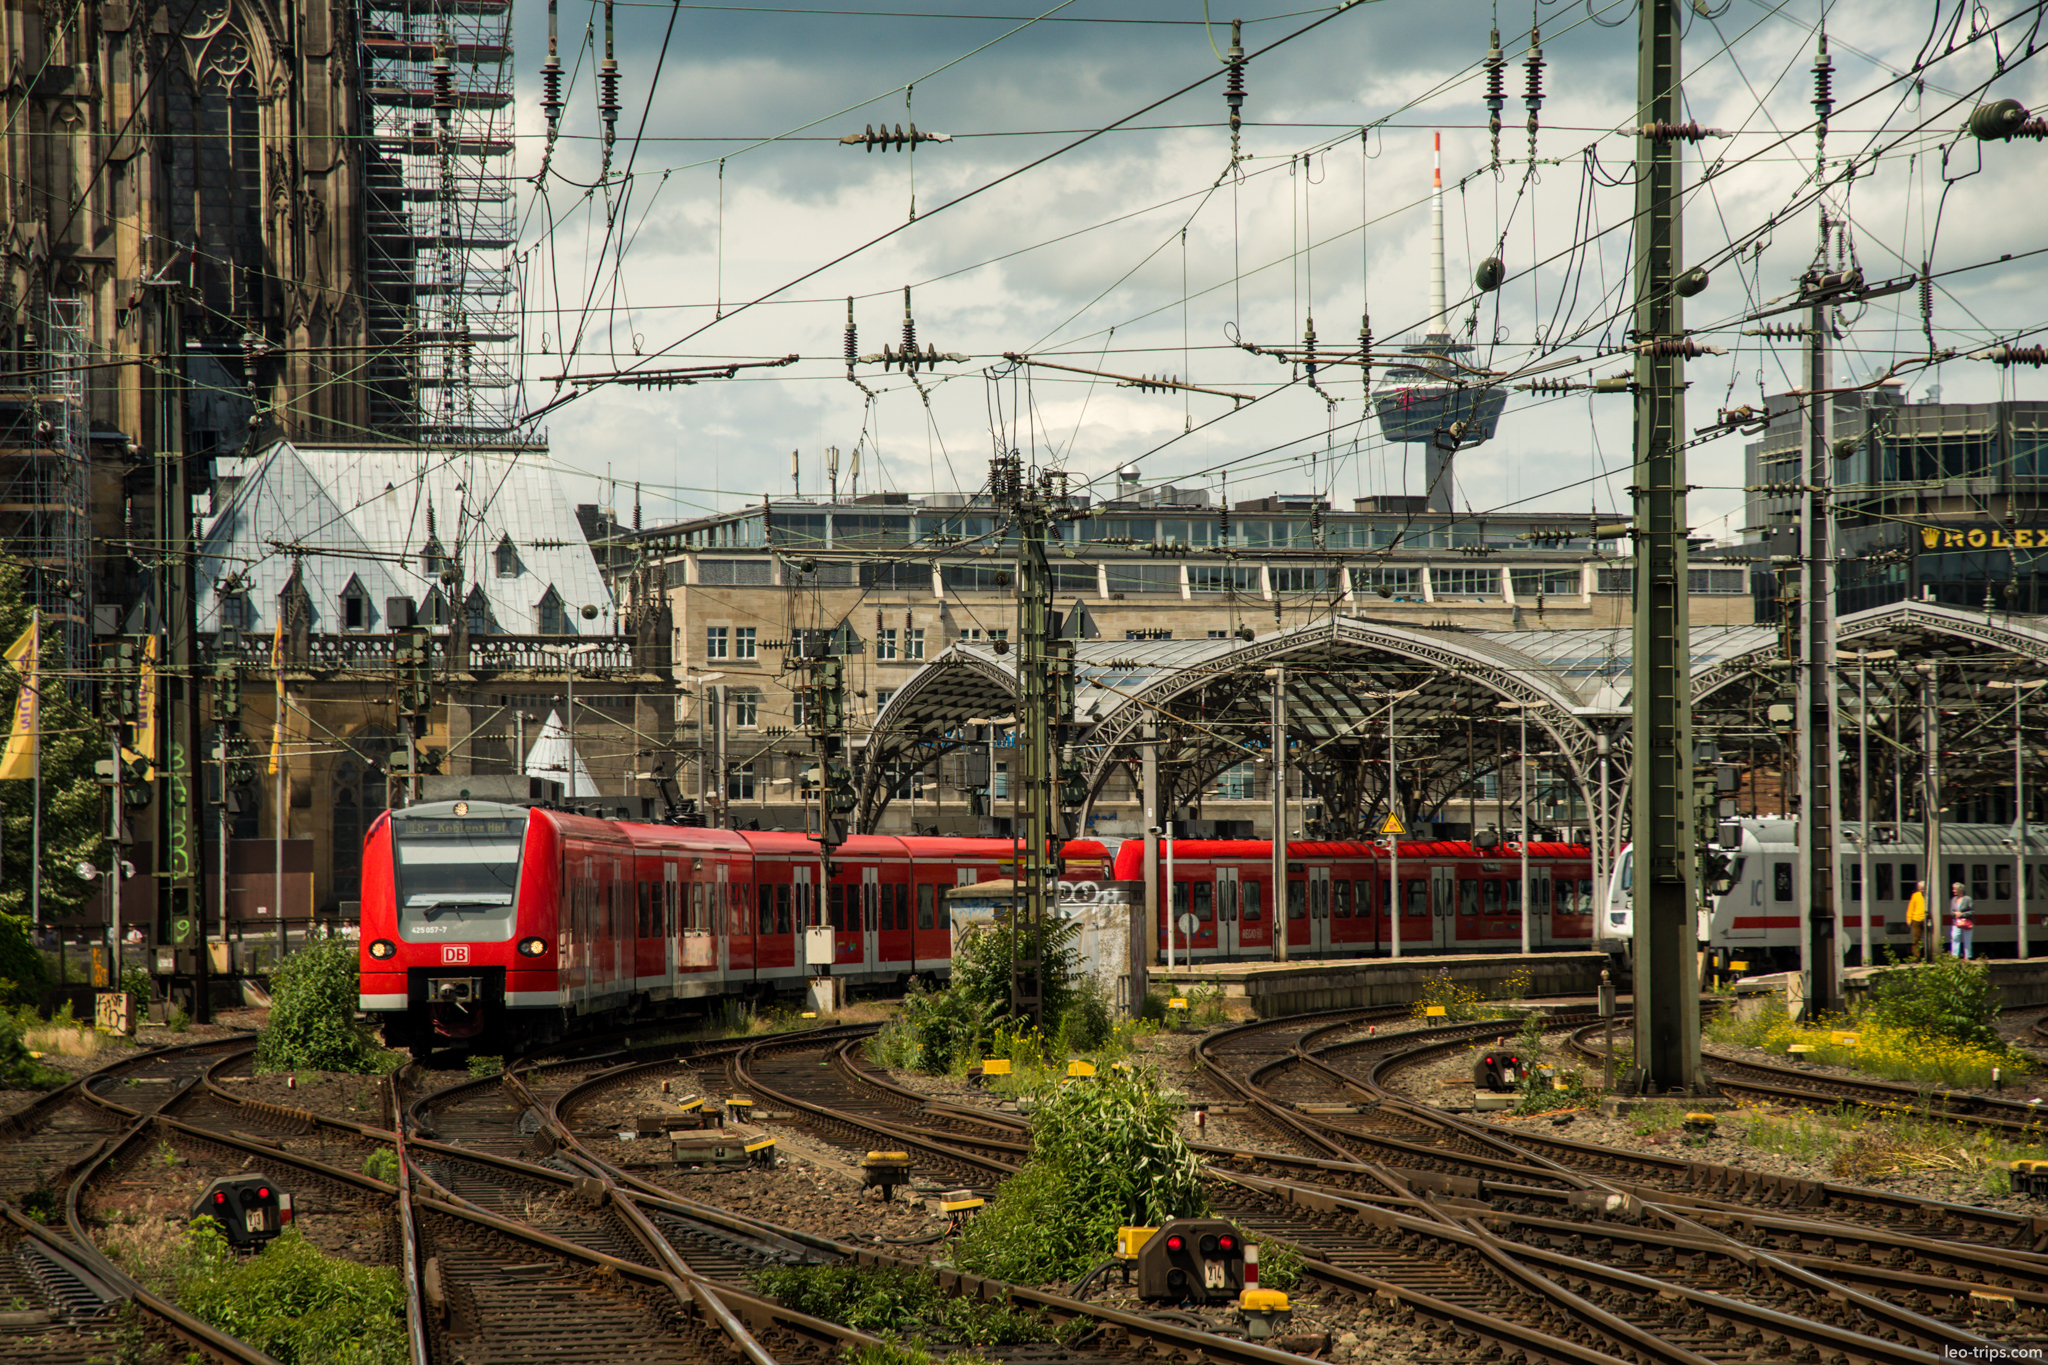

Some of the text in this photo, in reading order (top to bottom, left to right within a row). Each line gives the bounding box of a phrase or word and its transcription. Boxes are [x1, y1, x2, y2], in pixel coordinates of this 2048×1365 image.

[437, 821, 484, 833] Koblenz
[488, 821, 506, 832] Hbf
[1750, 879, 1762, 906] IC
[411, 926, 425, 934] 425
[445, 948, 466, 961] DB
[1208, 1266, 1221, 1281] 214
